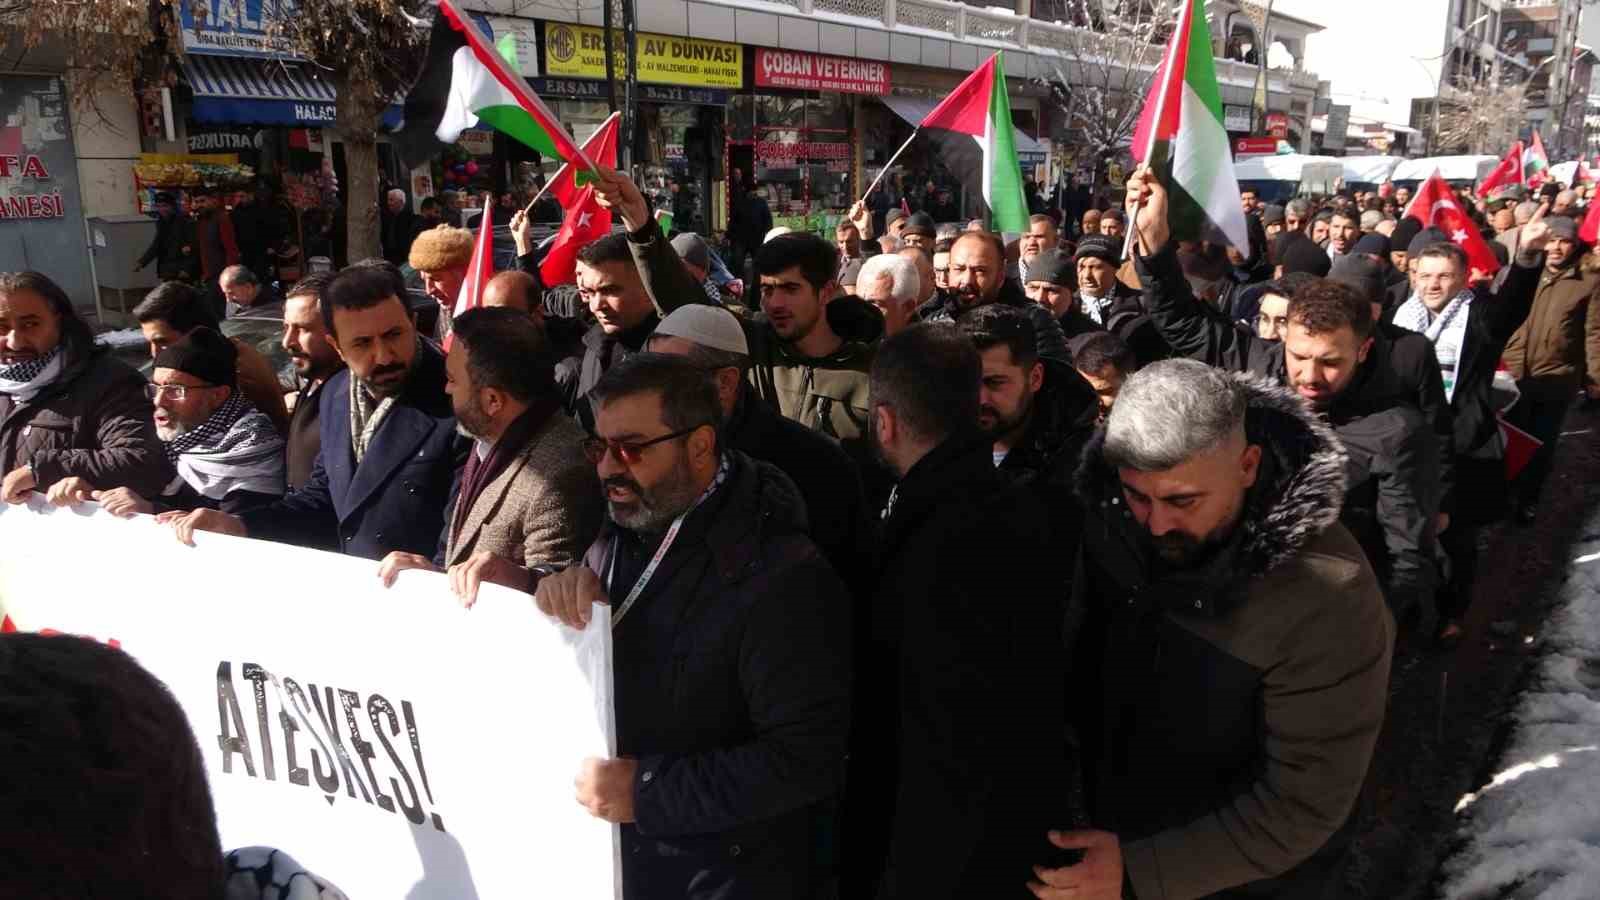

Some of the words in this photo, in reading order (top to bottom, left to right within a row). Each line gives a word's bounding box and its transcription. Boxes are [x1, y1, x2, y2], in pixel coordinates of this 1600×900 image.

[645, 40, 666, 56] AV
[671, 37, 737, 64] DÜNYASI
[763, 51, 812, 77] ÇOBAN
[816, 57, 884, 82] VETERİNER
[216, 660, 446, 832] ATEŞKES!
